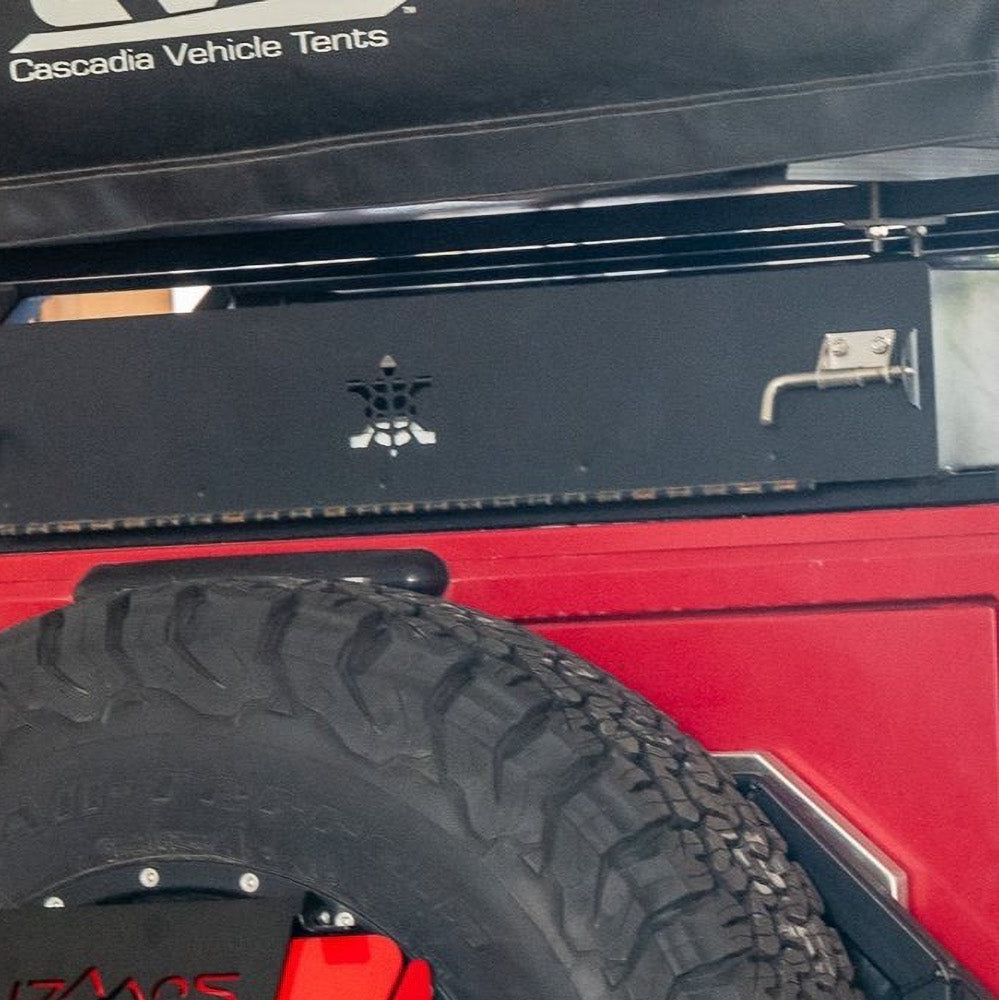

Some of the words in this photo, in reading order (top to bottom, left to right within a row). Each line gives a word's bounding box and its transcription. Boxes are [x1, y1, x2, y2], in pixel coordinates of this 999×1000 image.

[9, 49, 155, 83] Cascadia
[163, 36, 282, 67] Vehicle
[290, 28, 390, 55] Tents
